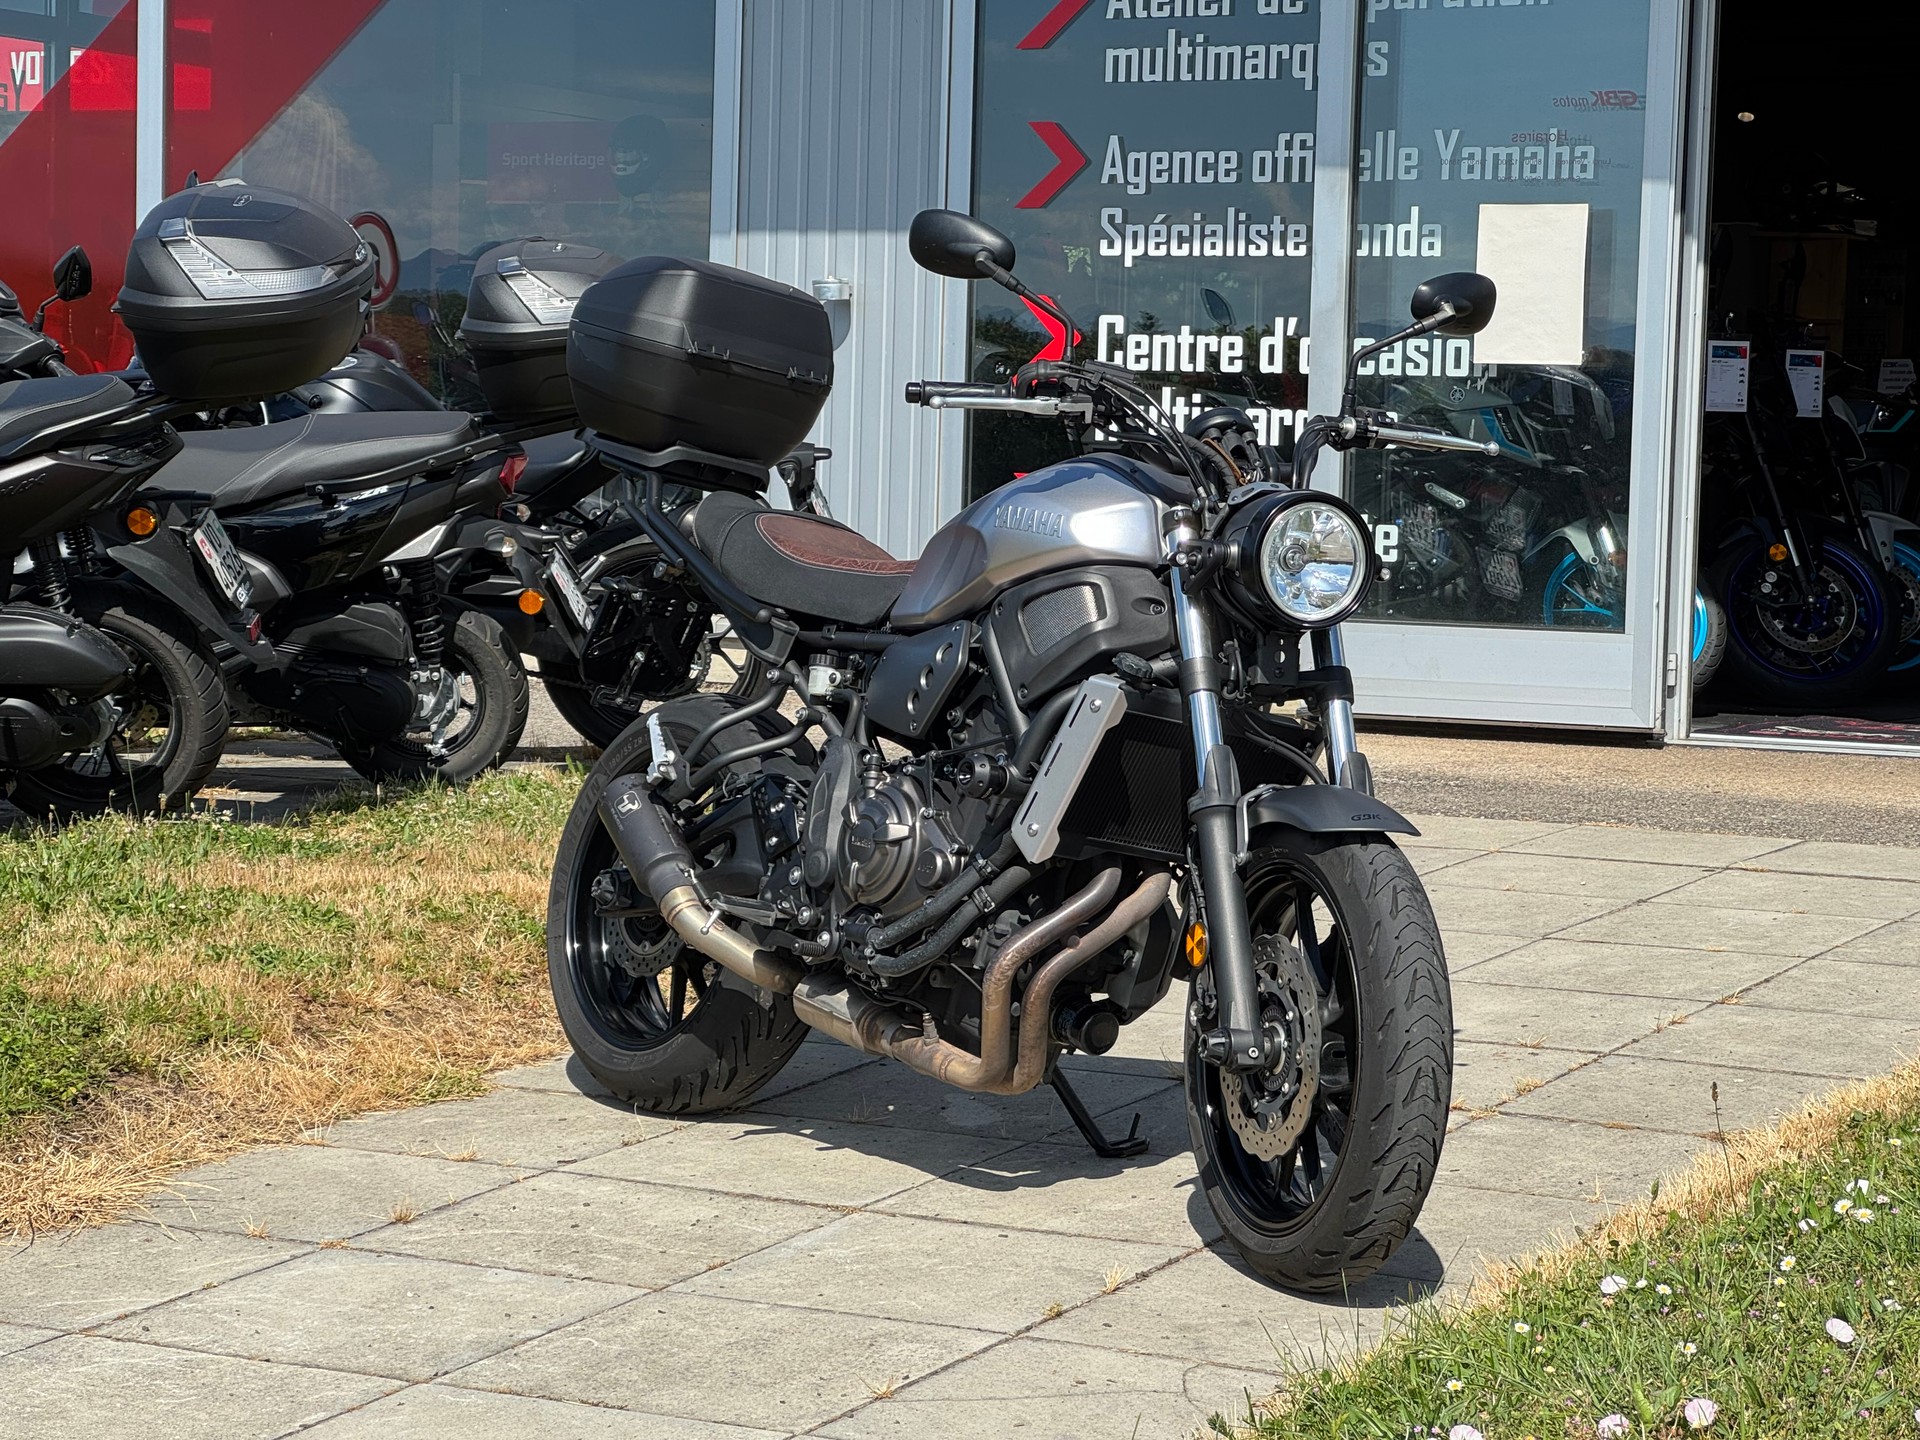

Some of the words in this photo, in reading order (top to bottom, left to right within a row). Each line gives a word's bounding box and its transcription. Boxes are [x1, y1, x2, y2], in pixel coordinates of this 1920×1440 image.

[1104, 28, 1389, 91] multimarqs
[502, 153, 541, 169] Sport
[544, 152, 605, 170] Heritage
[1100, 135, 1236, 195] Agence
[1252, 130, 1419, 183] offielle
[1433, 127, 1596, 181] Yamaha
[1099, 206, 1309, 268] Spécialiste
[1356, 206, 1442, 258] onda
[1097, 314, 1243, 375] Centre
[202, 523, 222, 553] VD
[994, 505, 1065, 538] YAMAHA
[216, 545, 244, 592] 40526
[1351, 813, 1381, 822] GBK
